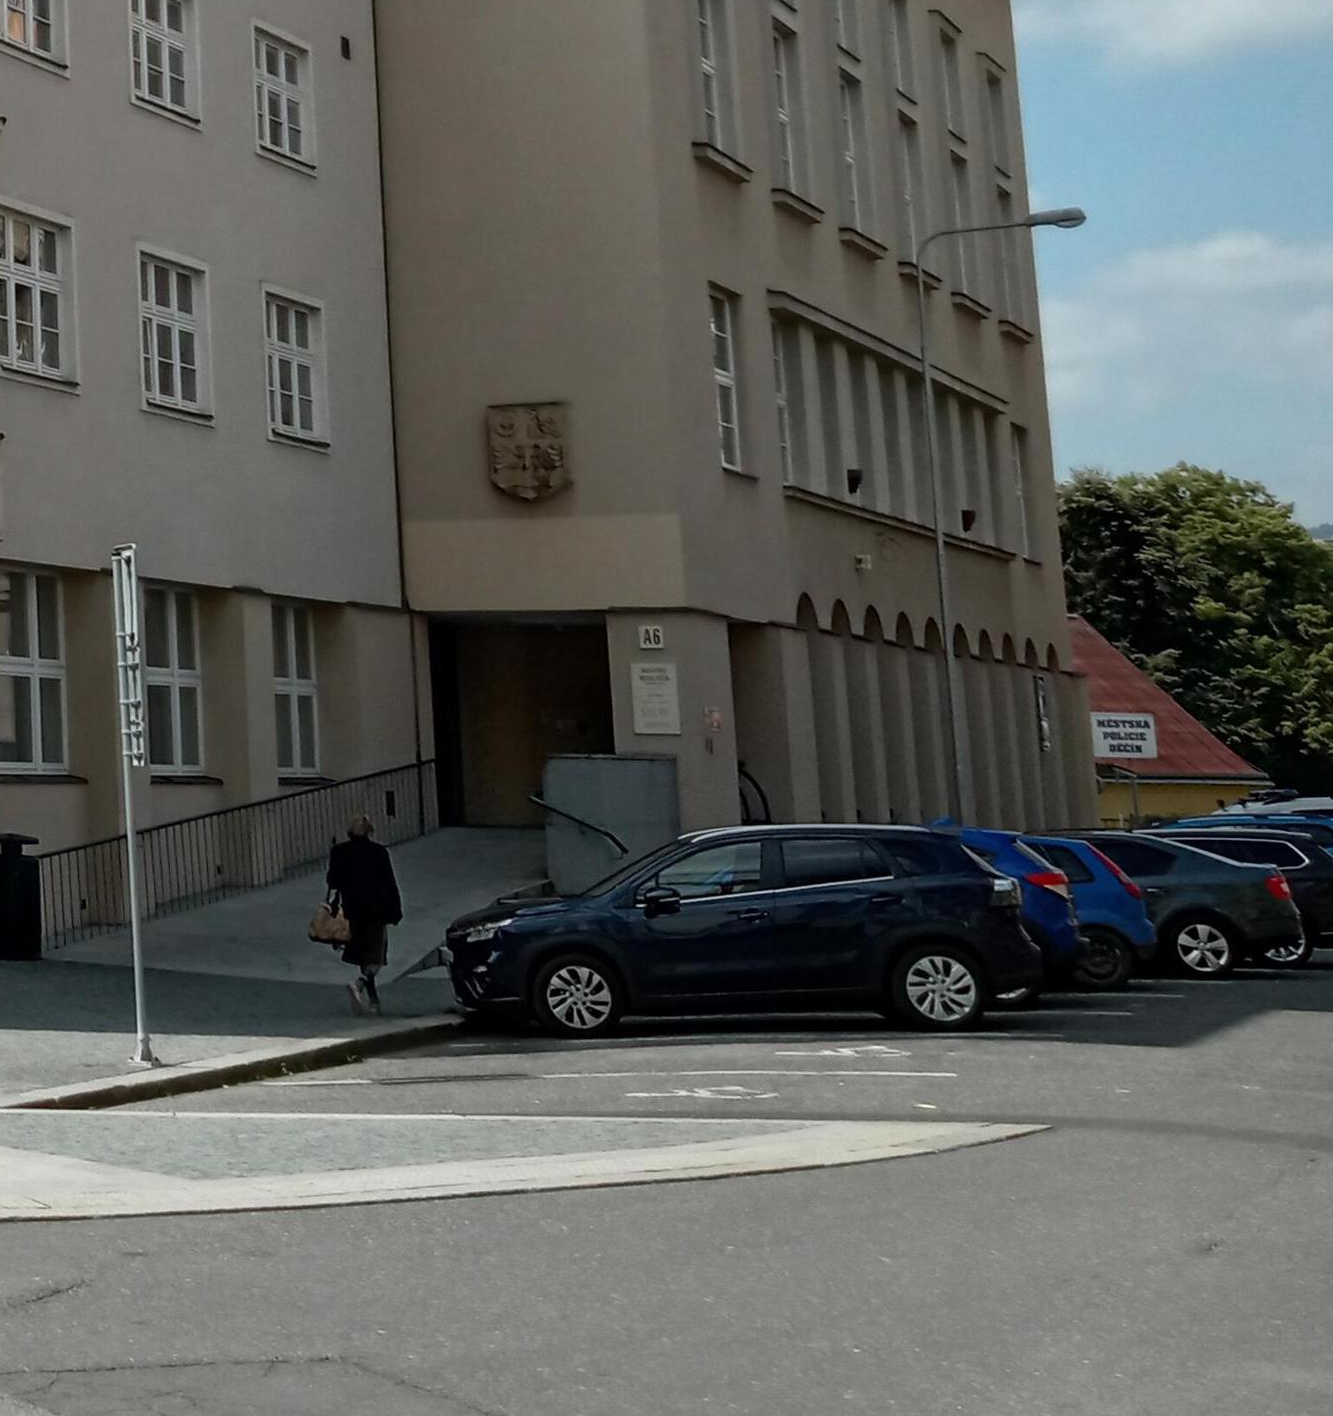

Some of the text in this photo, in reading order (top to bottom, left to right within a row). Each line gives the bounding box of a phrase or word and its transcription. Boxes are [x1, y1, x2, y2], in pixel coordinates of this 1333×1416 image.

[643, 628, 662, 645] A6
[1102, 731, 1147, 741] POLICIE
[1109, 742, 1143, 753] DĚČÍN
